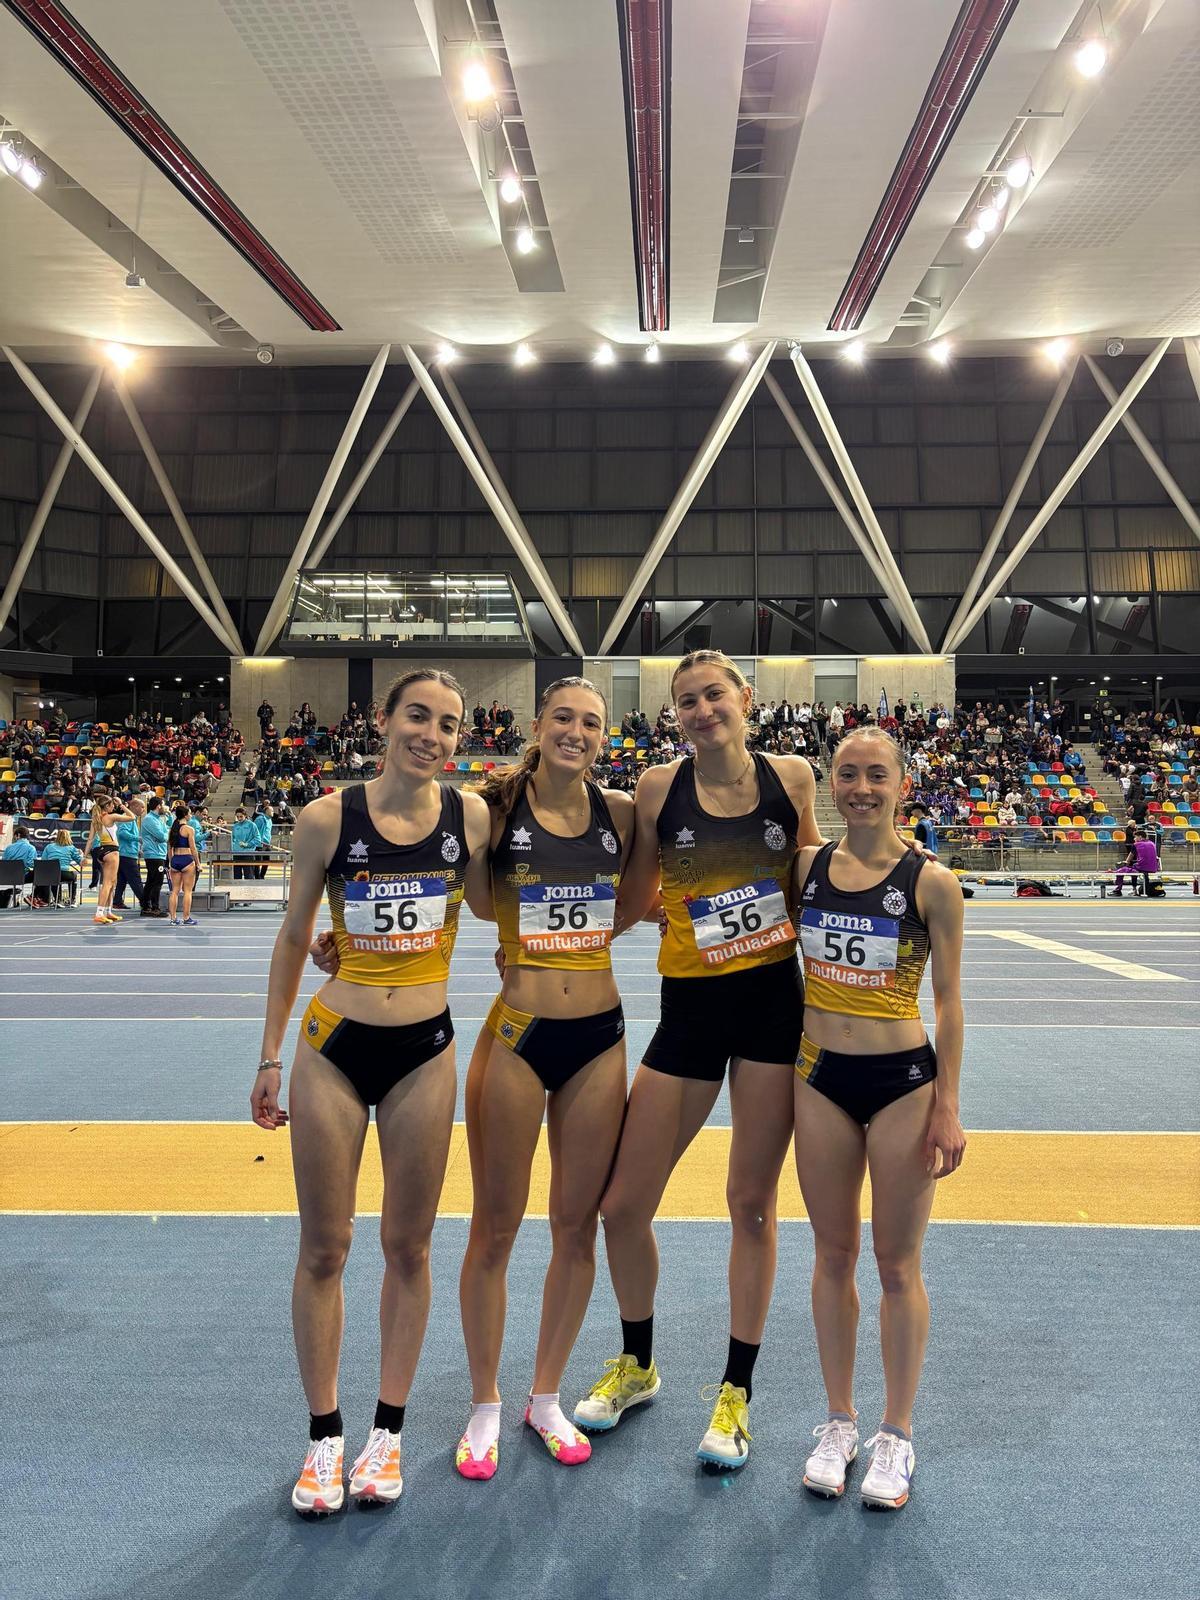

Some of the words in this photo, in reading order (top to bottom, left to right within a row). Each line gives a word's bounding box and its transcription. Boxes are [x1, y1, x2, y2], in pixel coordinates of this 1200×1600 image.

[374, 900, 418, 933] 56
[547, 903, 588, 931] 56
[719, 903, 762, 941] 56
[353, 933, 437, 951] mutuacat
[527, 932, 607, 952] mutuacat
[707, 925, 789, 963] mutuacat
[824, 932, 866, 966] 56
[811, 961, 887, 987] mutuacat
